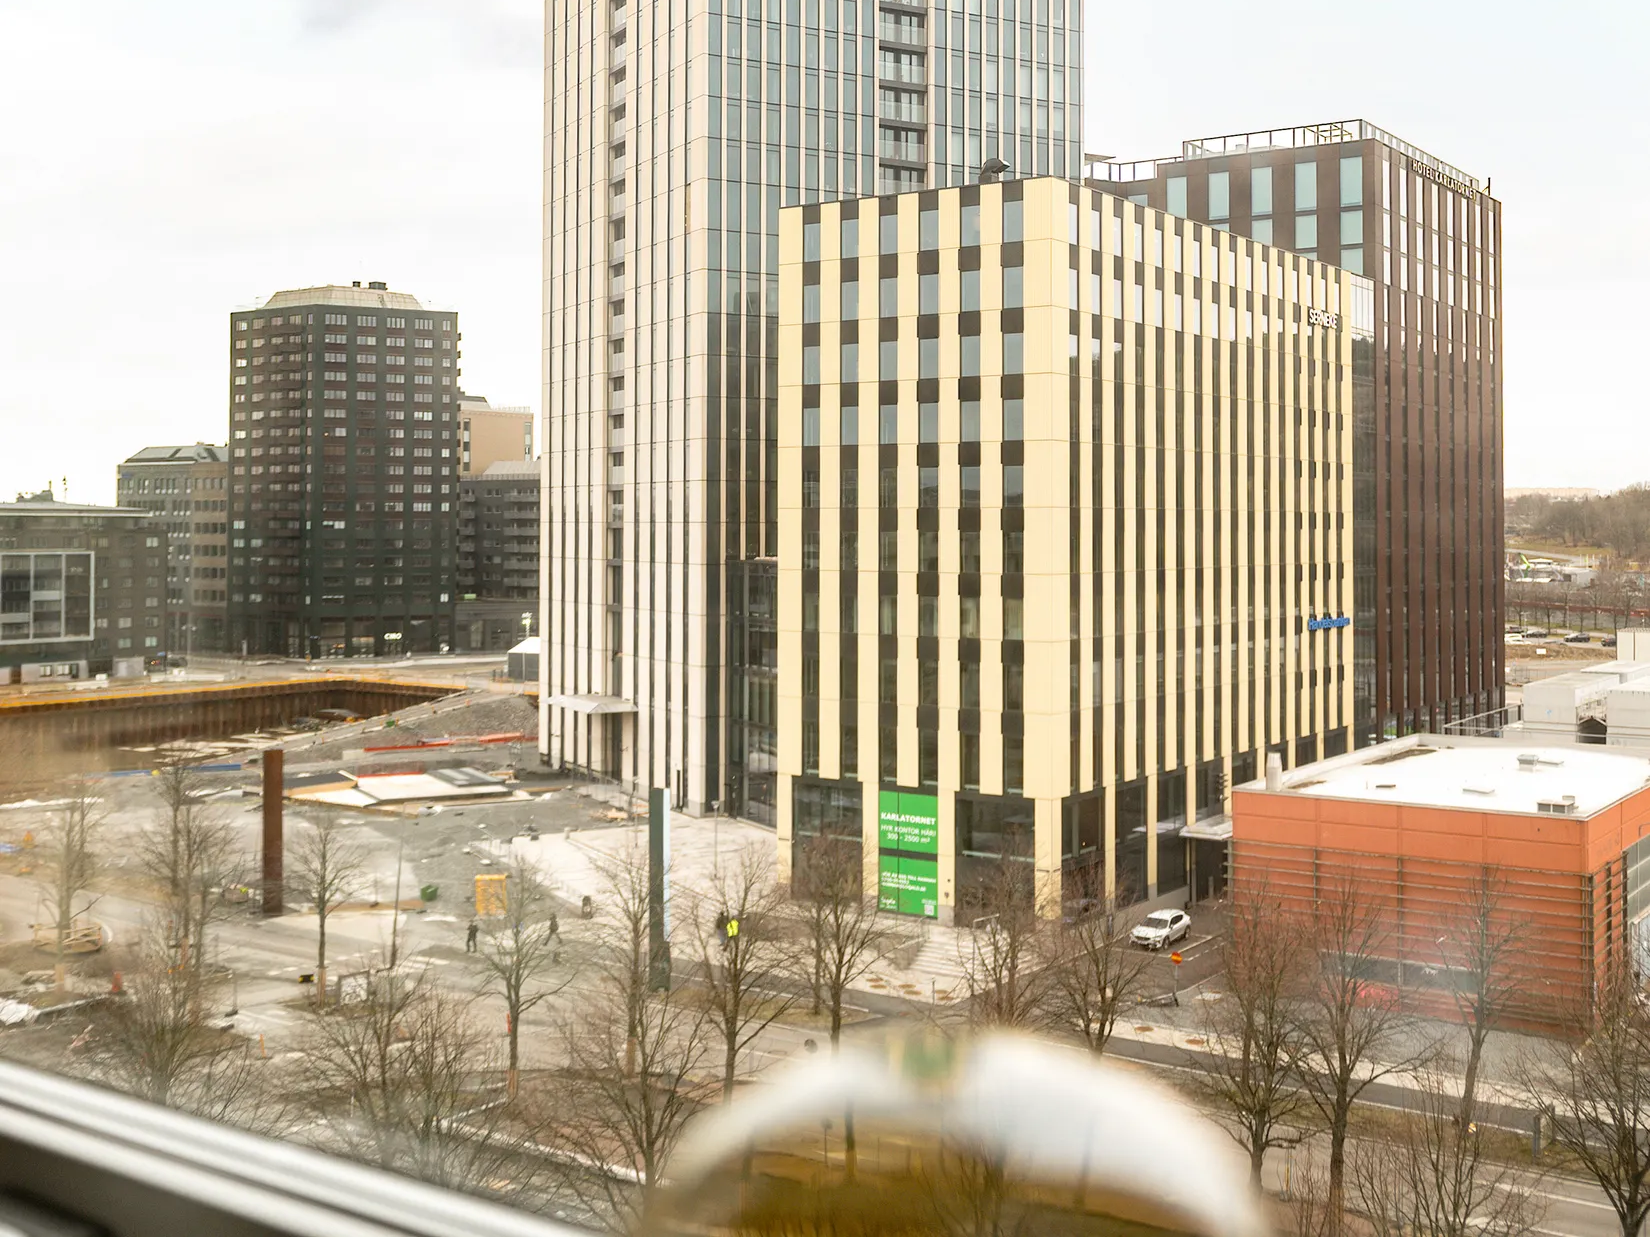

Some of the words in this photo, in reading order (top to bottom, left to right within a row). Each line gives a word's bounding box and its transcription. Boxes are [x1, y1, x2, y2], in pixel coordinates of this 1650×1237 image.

[1412, 160, 1434, 180] HOTEL
[1435, 171, 1476, 201] KARLATORNET
[1309, 308, 1338, 329] SERNEKE
[880, 812, 936, 825] KARLATORNET
[894, 826, 920, 834] KONTOR
